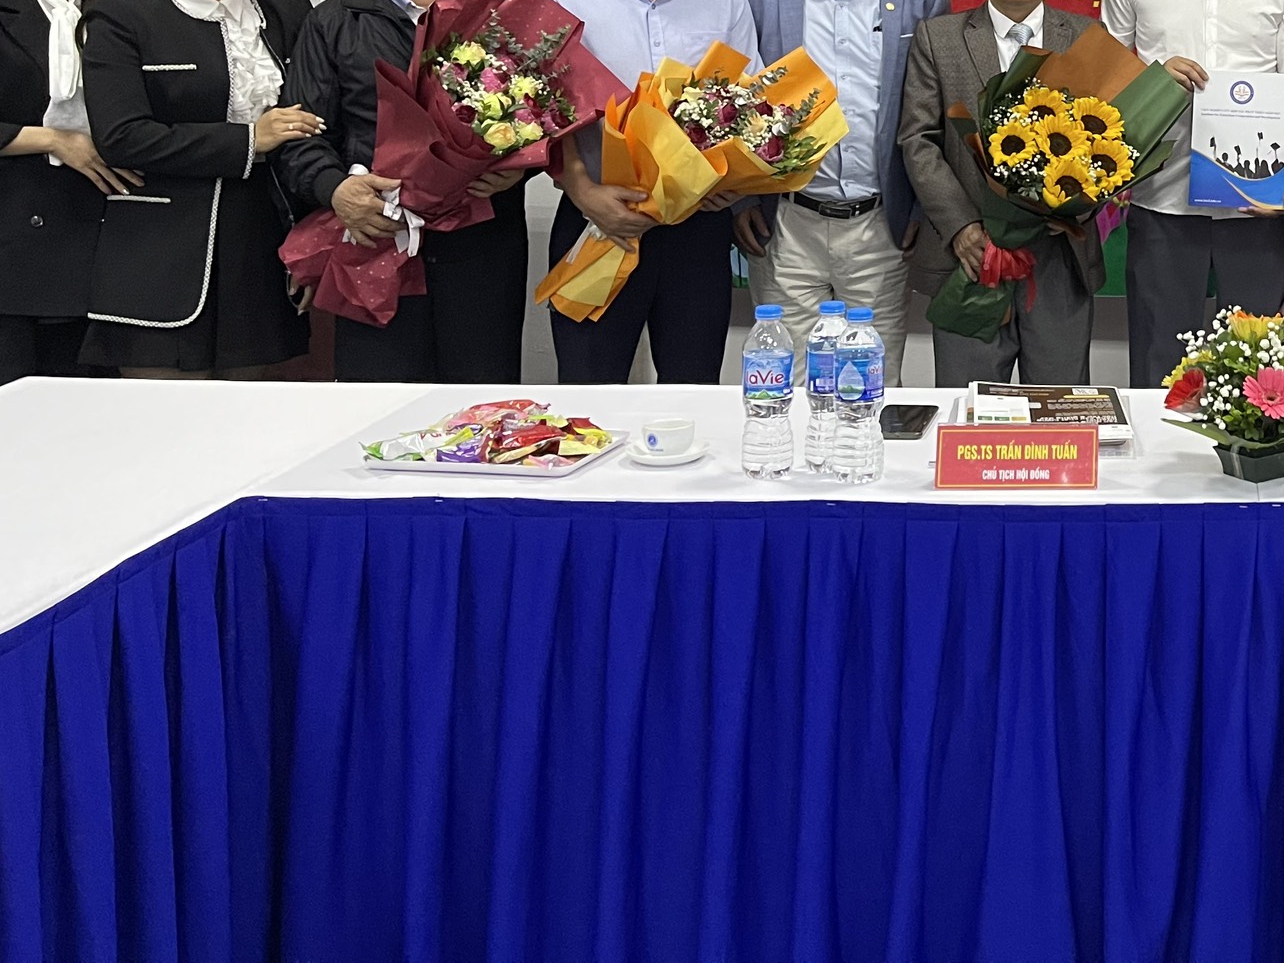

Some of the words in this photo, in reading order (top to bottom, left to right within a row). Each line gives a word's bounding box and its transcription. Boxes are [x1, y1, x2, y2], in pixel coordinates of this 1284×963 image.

[746, 369, 784, 385] laVie
[957, 444, 993, 460] PGS.TS
[1051, 439, 1078, 460] TUẤN
[999, 468, 1015, 482] TỊCH
[1016, 467, 1029, 482] HỘI
